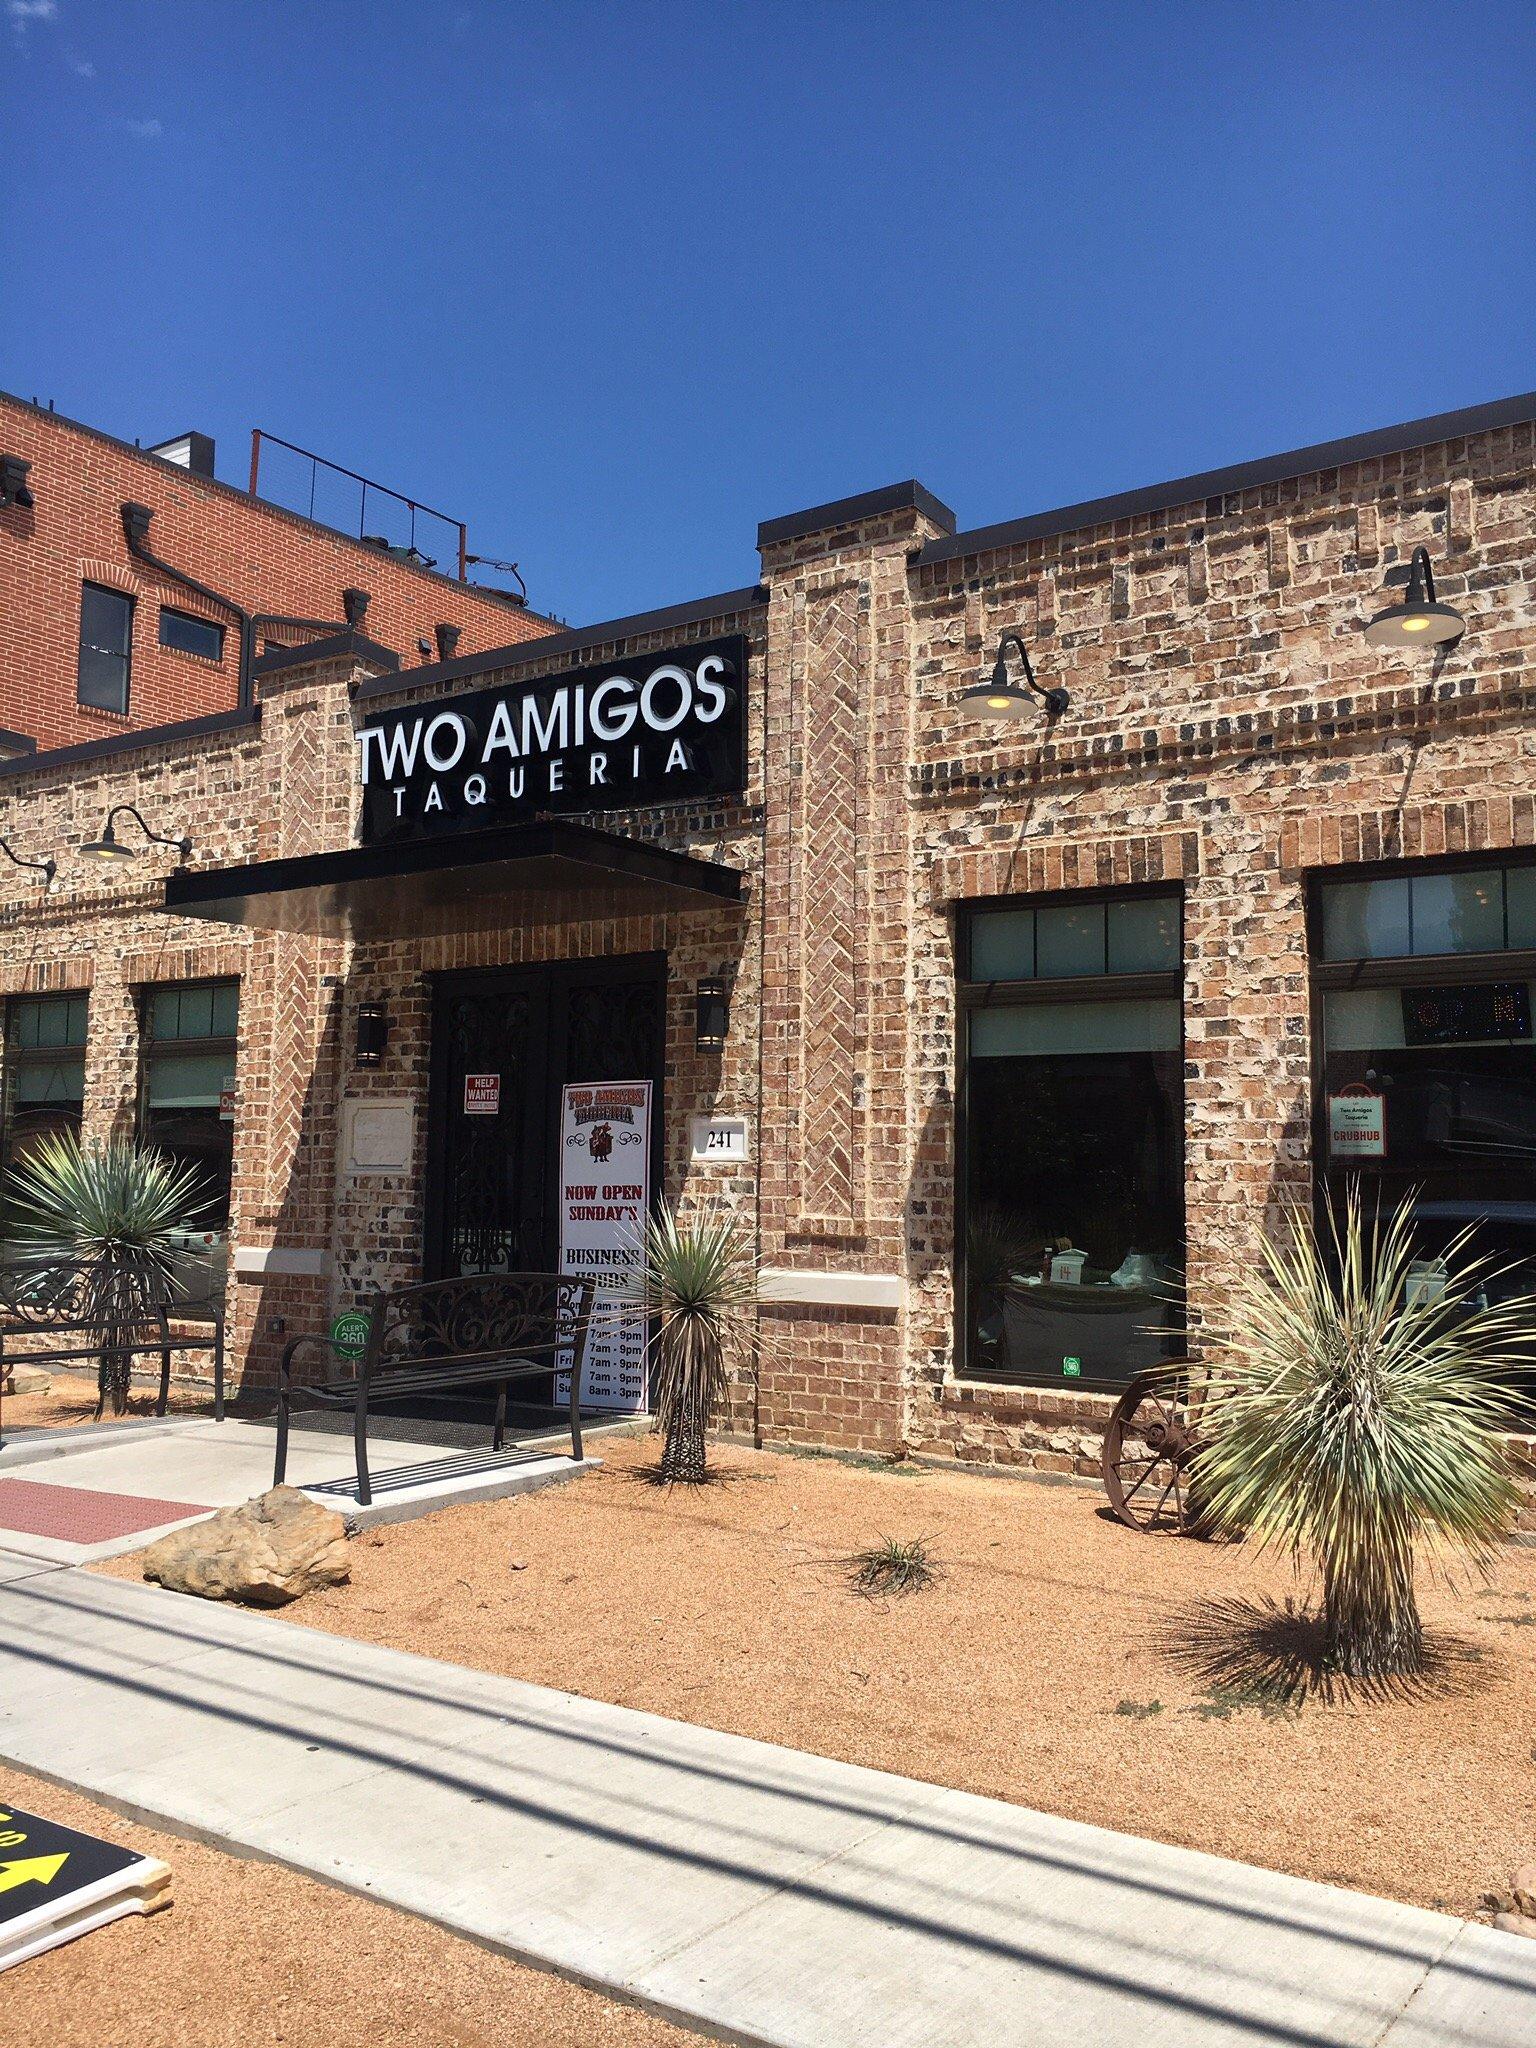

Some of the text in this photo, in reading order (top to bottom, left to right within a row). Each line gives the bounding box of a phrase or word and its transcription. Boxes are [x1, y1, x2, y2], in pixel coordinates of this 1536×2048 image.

[354, 655, 726, 785] TWO AMIGOS
[393, 738, 690, 817] TAQUERIA
[475, 1078, 494, 1088] HELP
[468, 1089, 498, 1100] WANTED
[708, 1130, 731, 1148] 241
[1333, 1130, 1380, 1141] GRUBHUB
[565, 1184, 643, 1201] NOW OPEN
[569, 1205, 638, 1221] SUNDAY'S
[566, 1248, 640, 1266] BUSINESS
[342, 1324, 364, 1332] ALERT
[341, 1332, 365, 1344] 360
[619, 1330, 642, 1341] 9pm
[589, 1343, 611, 1353] 7am
[619, 1344, 642, 1356] 9pm
[559, 1355, 572, 1364] Fri
[589, 1357, 611, 1367] 7am
[619, 1358, 642, 1370] 9pm
[589, 1371, 611, 1381] 7am
[619, 1373, 642, 1384] 9pm
[588, 1385, 611, 1396] 8am
[619, 1387, 642, 1399] 3pm
